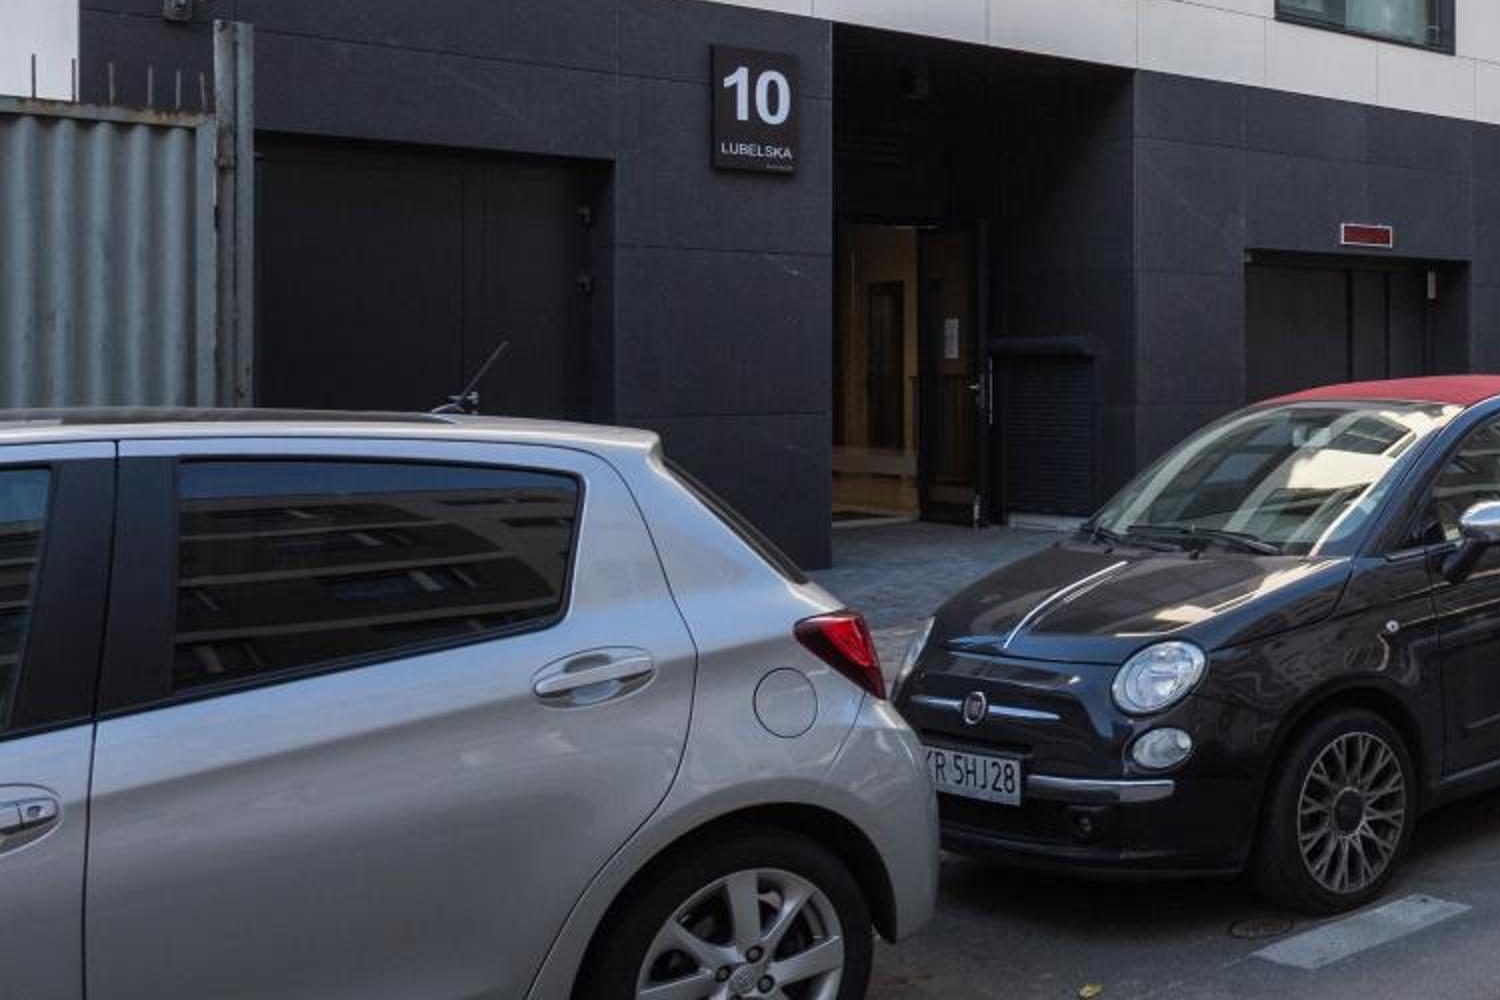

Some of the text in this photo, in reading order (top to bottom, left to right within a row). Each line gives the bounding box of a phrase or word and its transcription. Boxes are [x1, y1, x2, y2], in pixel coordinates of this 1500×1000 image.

[723, 66, 791, 125] 10
[721, 142, 793, 160] LUBELSKA
[953, 754, 1015, 794] 5HJ28
